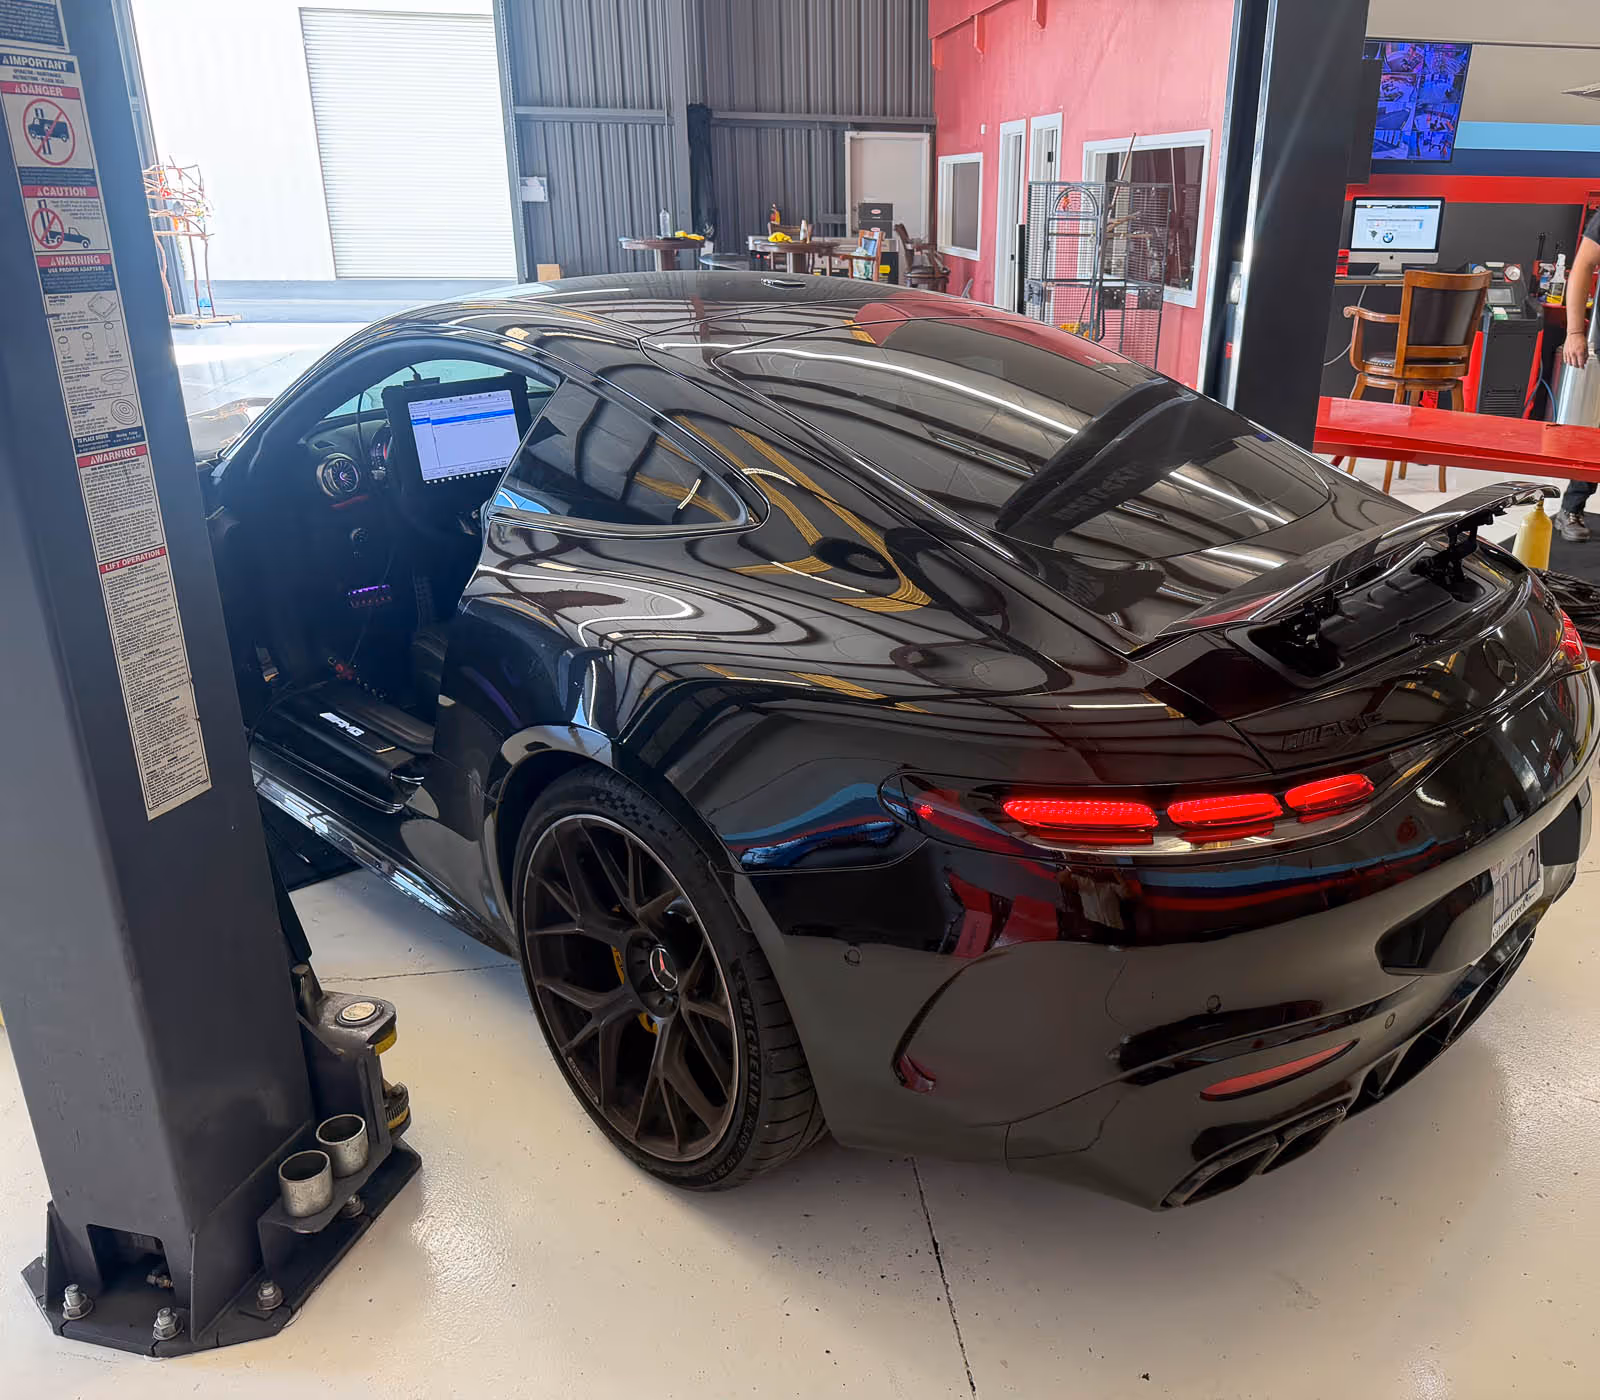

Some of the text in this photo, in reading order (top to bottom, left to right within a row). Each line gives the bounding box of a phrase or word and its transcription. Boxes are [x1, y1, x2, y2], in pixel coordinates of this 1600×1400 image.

[9, 56, 67, 71] IMPORTANT
[20, 83, 63, 96] DANGER
[43, 187, 87, 196] CAUTION
[56, 255, 101, 266] WARNING
[95, 448, 137, 463] WARNING
[105, 549, 160, 571] LIFT OPERATION
[741, 997, 760, 1107] MICHELIN
